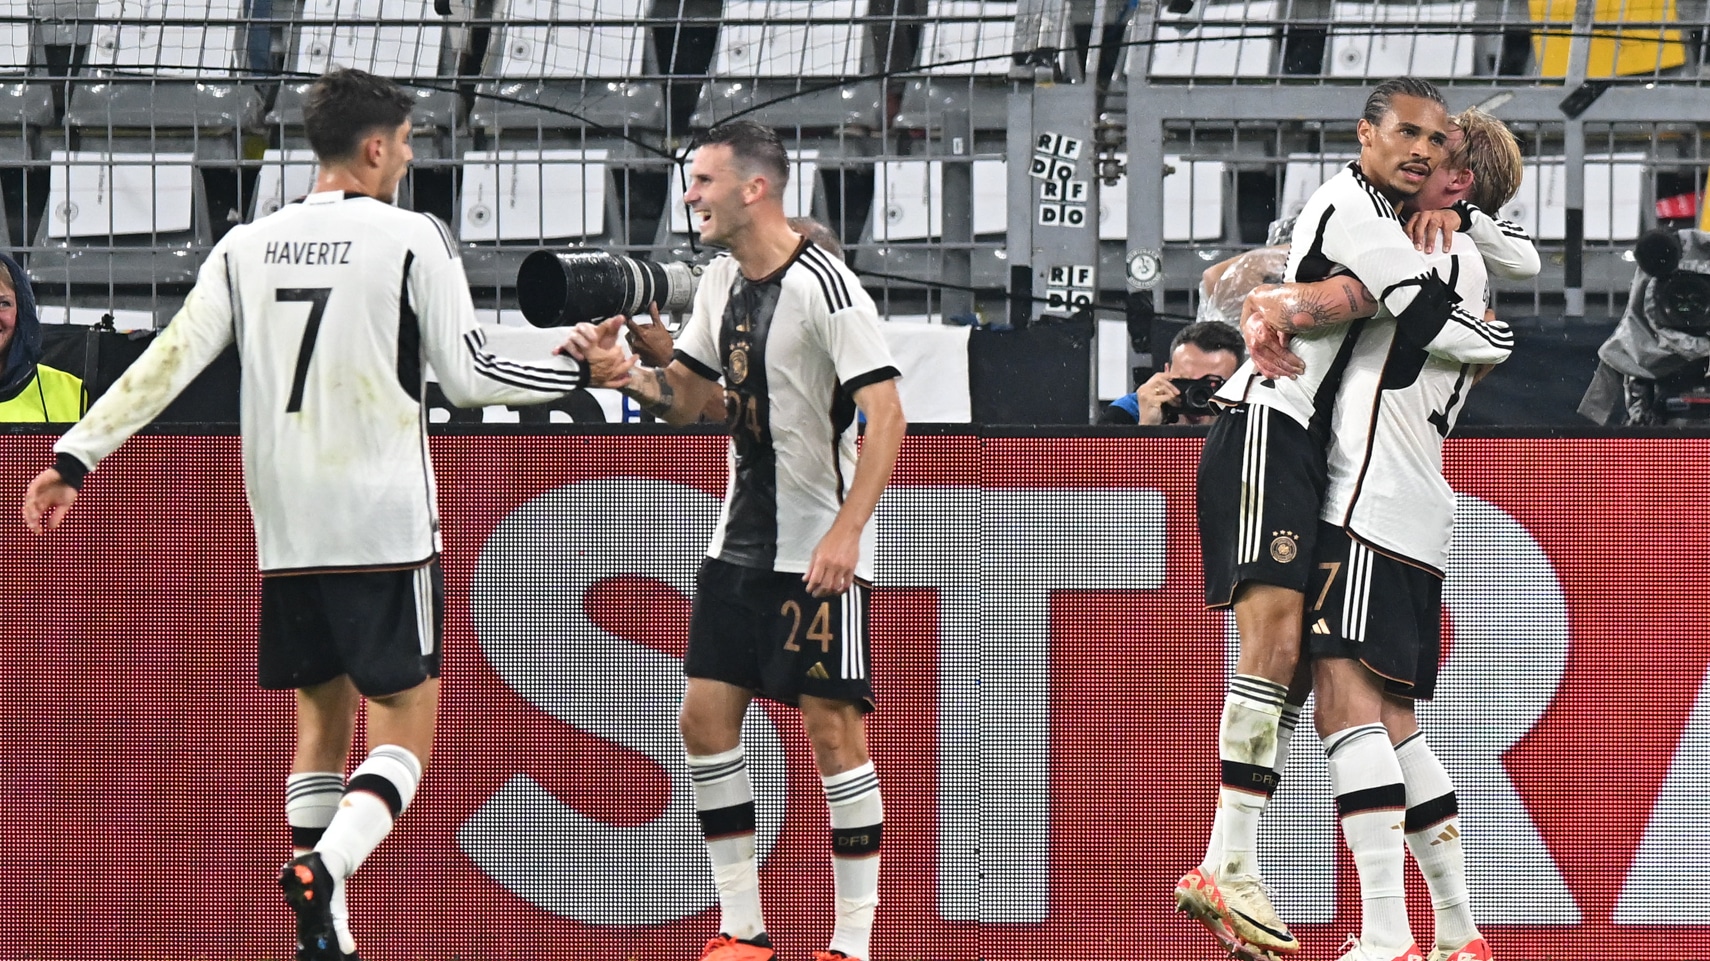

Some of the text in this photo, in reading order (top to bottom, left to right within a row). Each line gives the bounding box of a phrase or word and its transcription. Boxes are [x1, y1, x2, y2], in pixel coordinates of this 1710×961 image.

[264, 241, 352, 265] HAVERTZ
[275, 287, 333, 413] 7
[780, 600, 833, 653] 24
[838, 834, 869, 847] DFB
